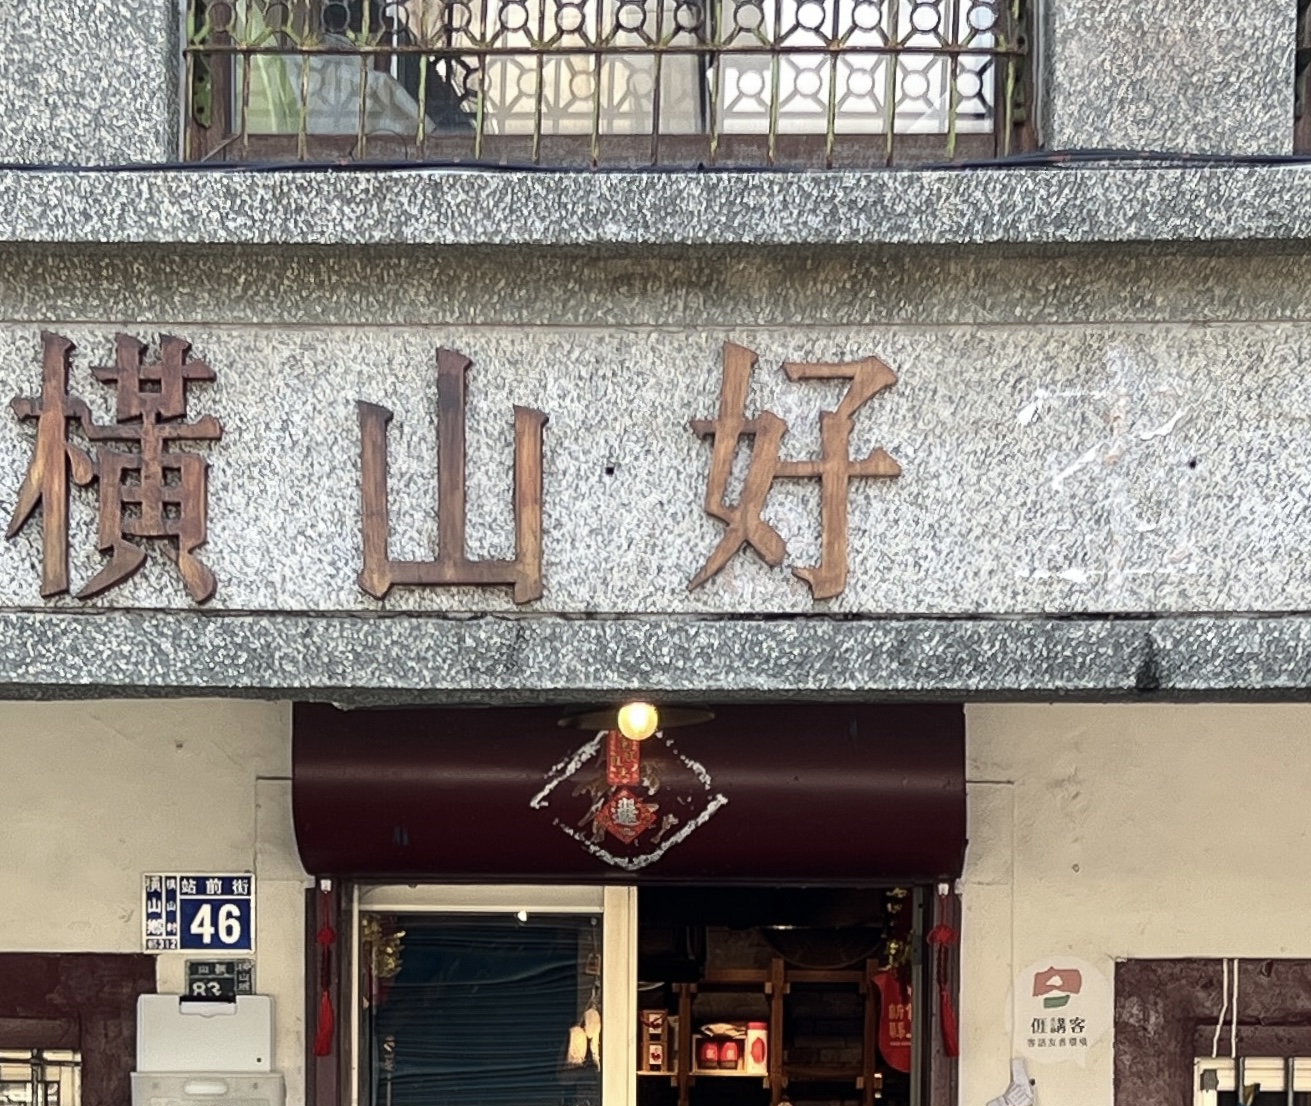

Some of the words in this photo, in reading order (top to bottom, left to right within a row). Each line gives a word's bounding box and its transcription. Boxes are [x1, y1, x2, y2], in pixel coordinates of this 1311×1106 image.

[6, 331, 901, 603] 橫山好
[181, 878, 250, 895] 站前街
[190, 903, 242, 944] 46
